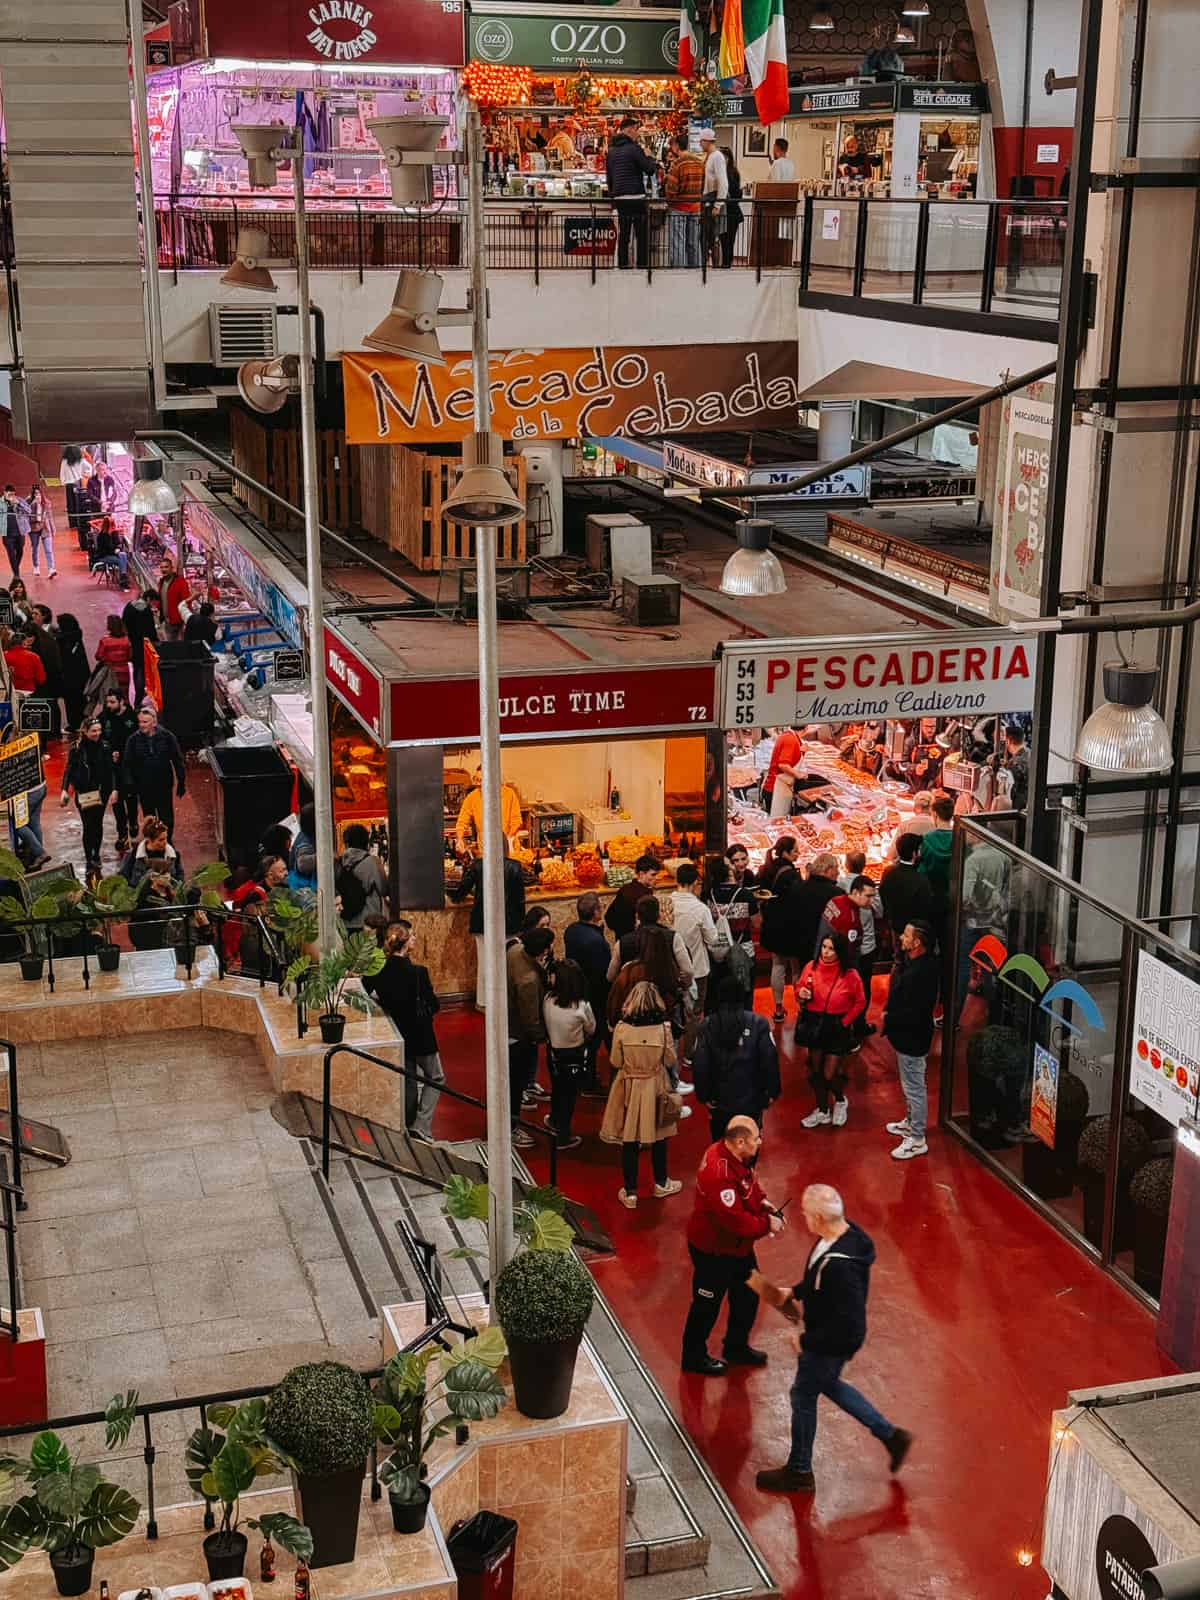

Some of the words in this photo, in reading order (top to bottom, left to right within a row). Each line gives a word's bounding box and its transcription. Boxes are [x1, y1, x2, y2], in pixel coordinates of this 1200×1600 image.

[308, 0, 373, 28] CARNES
[440, 1, 461, 13] 195
[306, 27, 332, 58] DEL
[334, 29, 377, 60] FUEGO
[550, 23, 627, 54] OZO
[369, 346, 648, 437] Mercado
[578, 353, 800, 438] Cebada
[511, 416, 538, 440] de
[541, 409, 563, 434] la
[666, 447, 697, 476] Modas
[1018, 447, 1050, 471] MERC
[1015, 483, 1040, 517] CE
[737, 659, 755, 679] 54
[766, 645, 1030, 694] PESCADERIA
[497, 695, 556, 718] ULCE
[568, 690, 626, 713] TIME
[736, 682, 754, 702] 53
[795, 696, 888, 720] Maximo
[894, 690, 986, 713] Cadierno
[688, 706, 707, 720] 72
[736, 705, 754, 725] 55
[1141, 959, 1161, 998] SE
